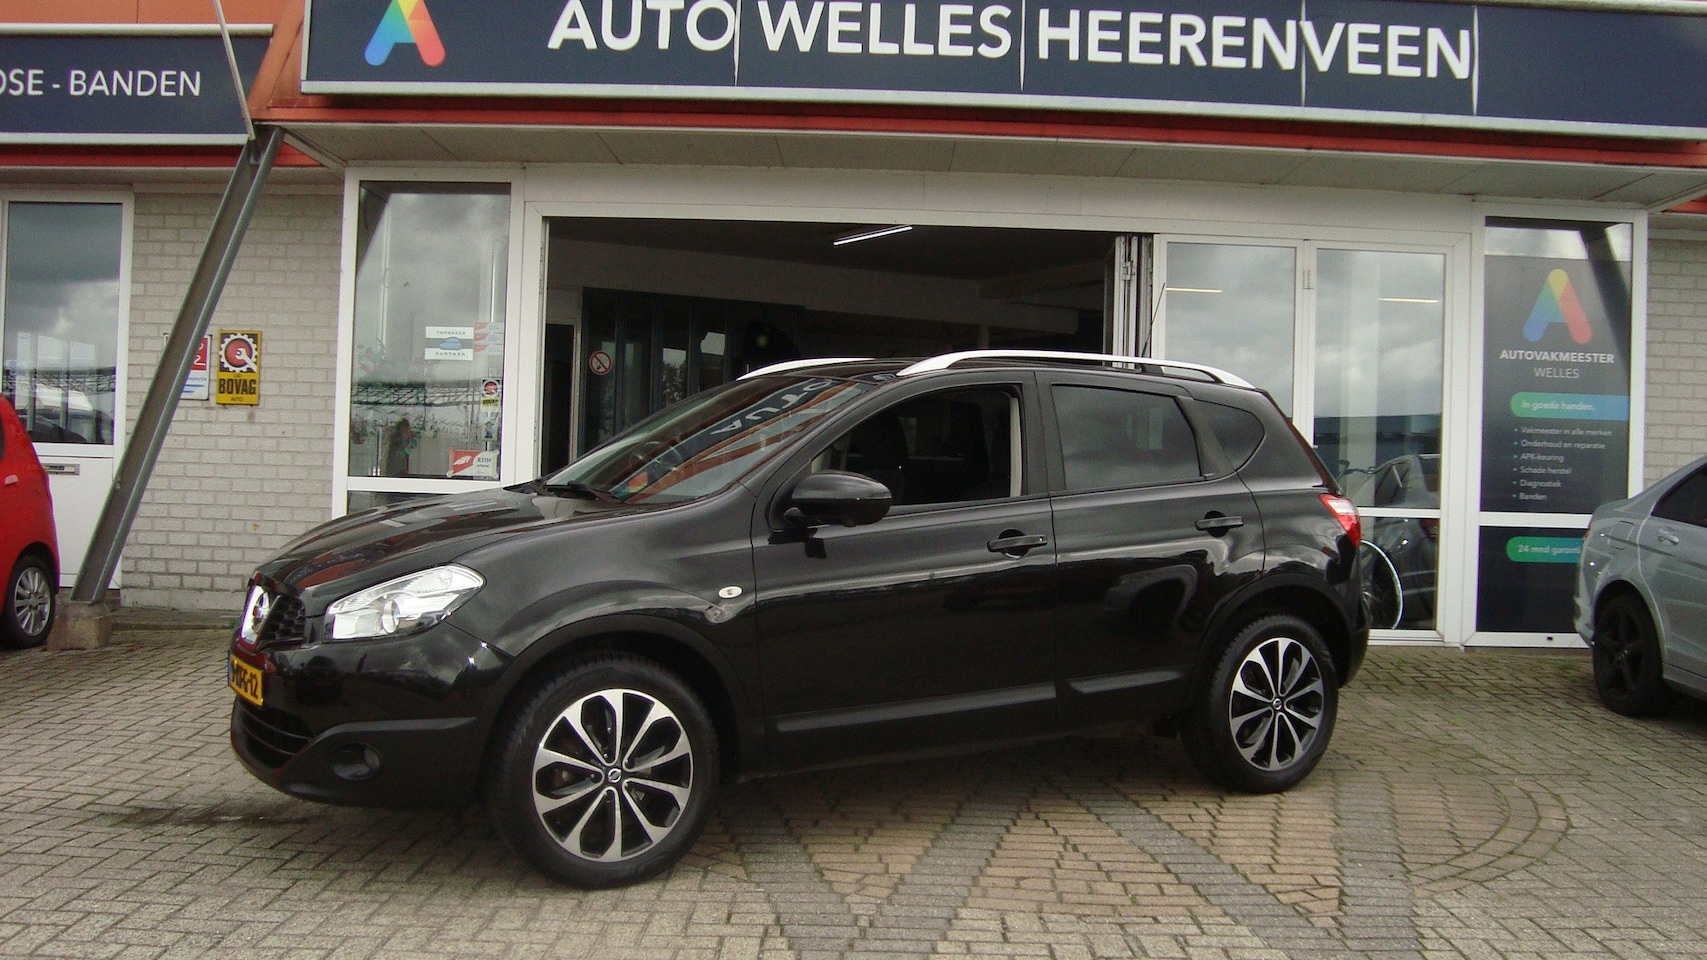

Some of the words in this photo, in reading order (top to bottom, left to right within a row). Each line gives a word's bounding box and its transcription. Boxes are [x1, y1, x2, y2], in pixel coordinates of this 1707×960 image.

[547, 0, 735, 52] AUTO
[757, 0, 1012, 59] WELLES
[1037, 8, 1471, 80] HEERENVEEN
[69, 69, 201, 97] BANDEN
[1499, 350, 1615, 364] AUTOVAKMEESTER
[1534, 367, 1580, 379] WELLES
[218, 378, 257, 395] BOVAG
[1531, 400, 1559, 411] goede
[1521, 439, 1562, 448] Onderhoud
[1519, 479, 1562, 489] Diagnostiek
[1519, 492, 1548, 500] Banden
[1517, 544, 1530, 553] 24
